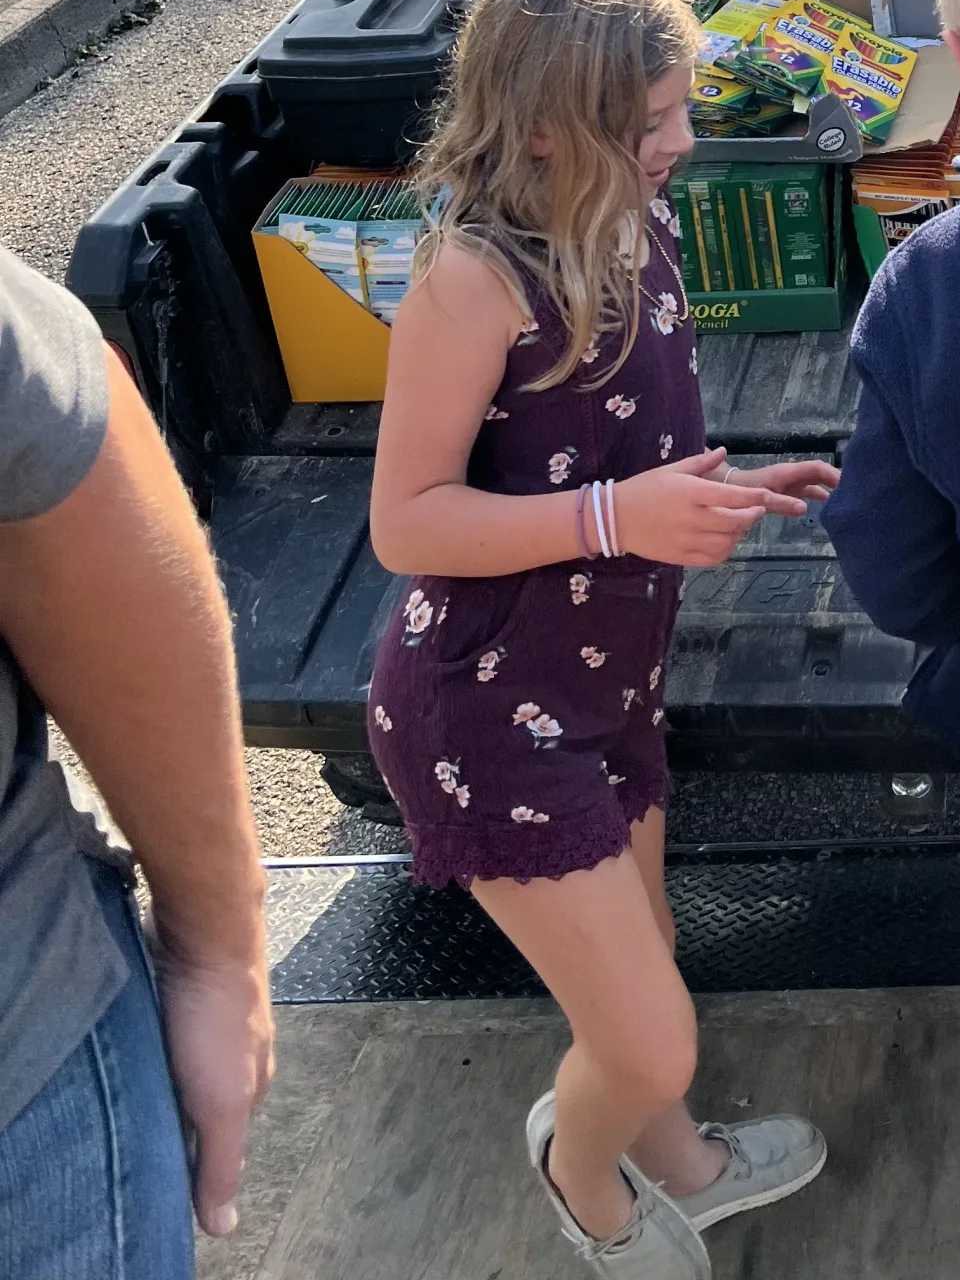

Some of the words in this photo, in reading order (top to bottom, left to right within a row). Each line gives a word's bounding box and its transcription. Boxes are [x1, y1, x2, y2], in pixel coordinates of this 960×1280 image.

[855, 31, 903, 57] Crayola
[780, 53, 795, 64] 12
[832, 56, 903, 94] Erasable
[832, 67, 867, 83] COLORED
[867, 80, 898, 99] PENCILS
[702, 86, 718, 96] 12
[819, 131, 842, 146] College
[823, 137, 842, 149] Ruled
[693, 319, 729, 329] Pencil
